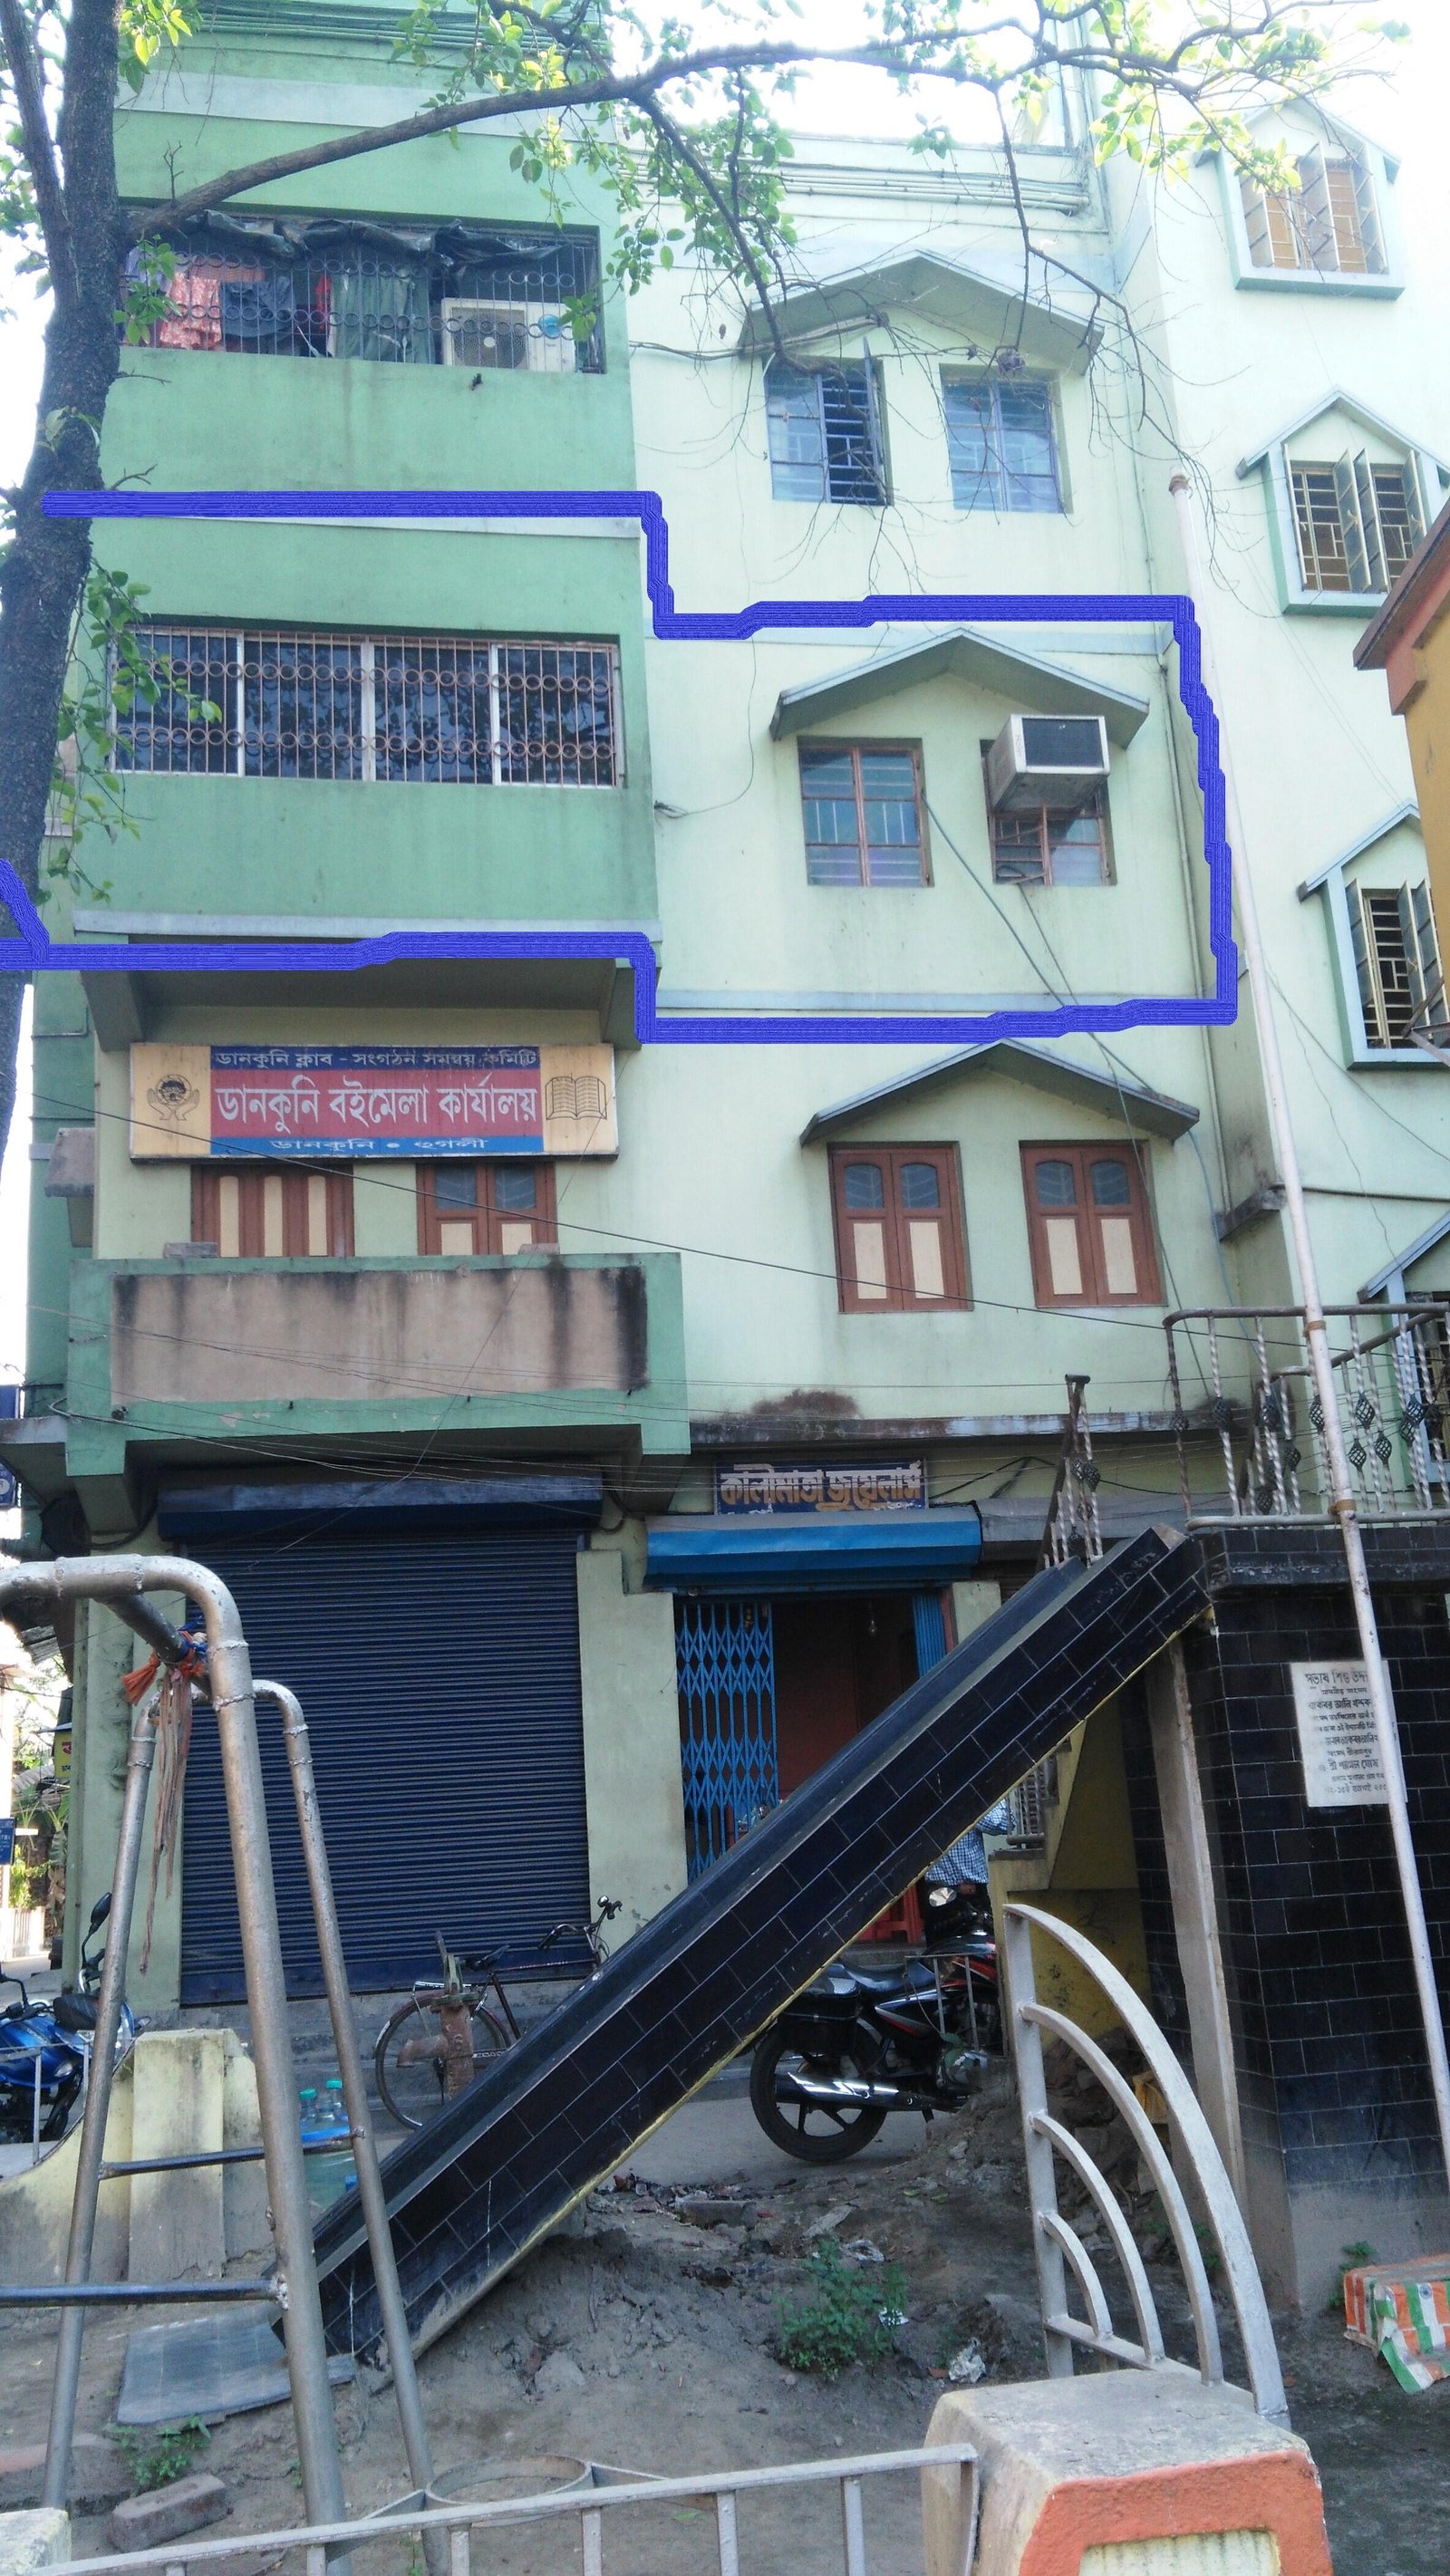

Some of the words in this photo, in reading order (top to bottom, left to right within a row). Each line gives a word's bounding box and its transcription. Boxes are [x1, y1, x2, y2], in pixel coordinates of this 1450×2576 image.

[216, 1048, 290, 1069] ডানকুনি
[295, 1052, 334, 1068] ক্লাব
[353, 1048, 416, 1066] সংগঠন
[483, 1048, 536, 1067] কমিটি
[215, 1075, 320, 1134] ডানকুনি
[328, 1076, 429, 1127] বইমেলা
[436, 1072, 537, 1123] কার্যালয়
[270, 1138, 375, 1152] ডানকুনি
[414, 1137, 488, 1150] হুগলী
